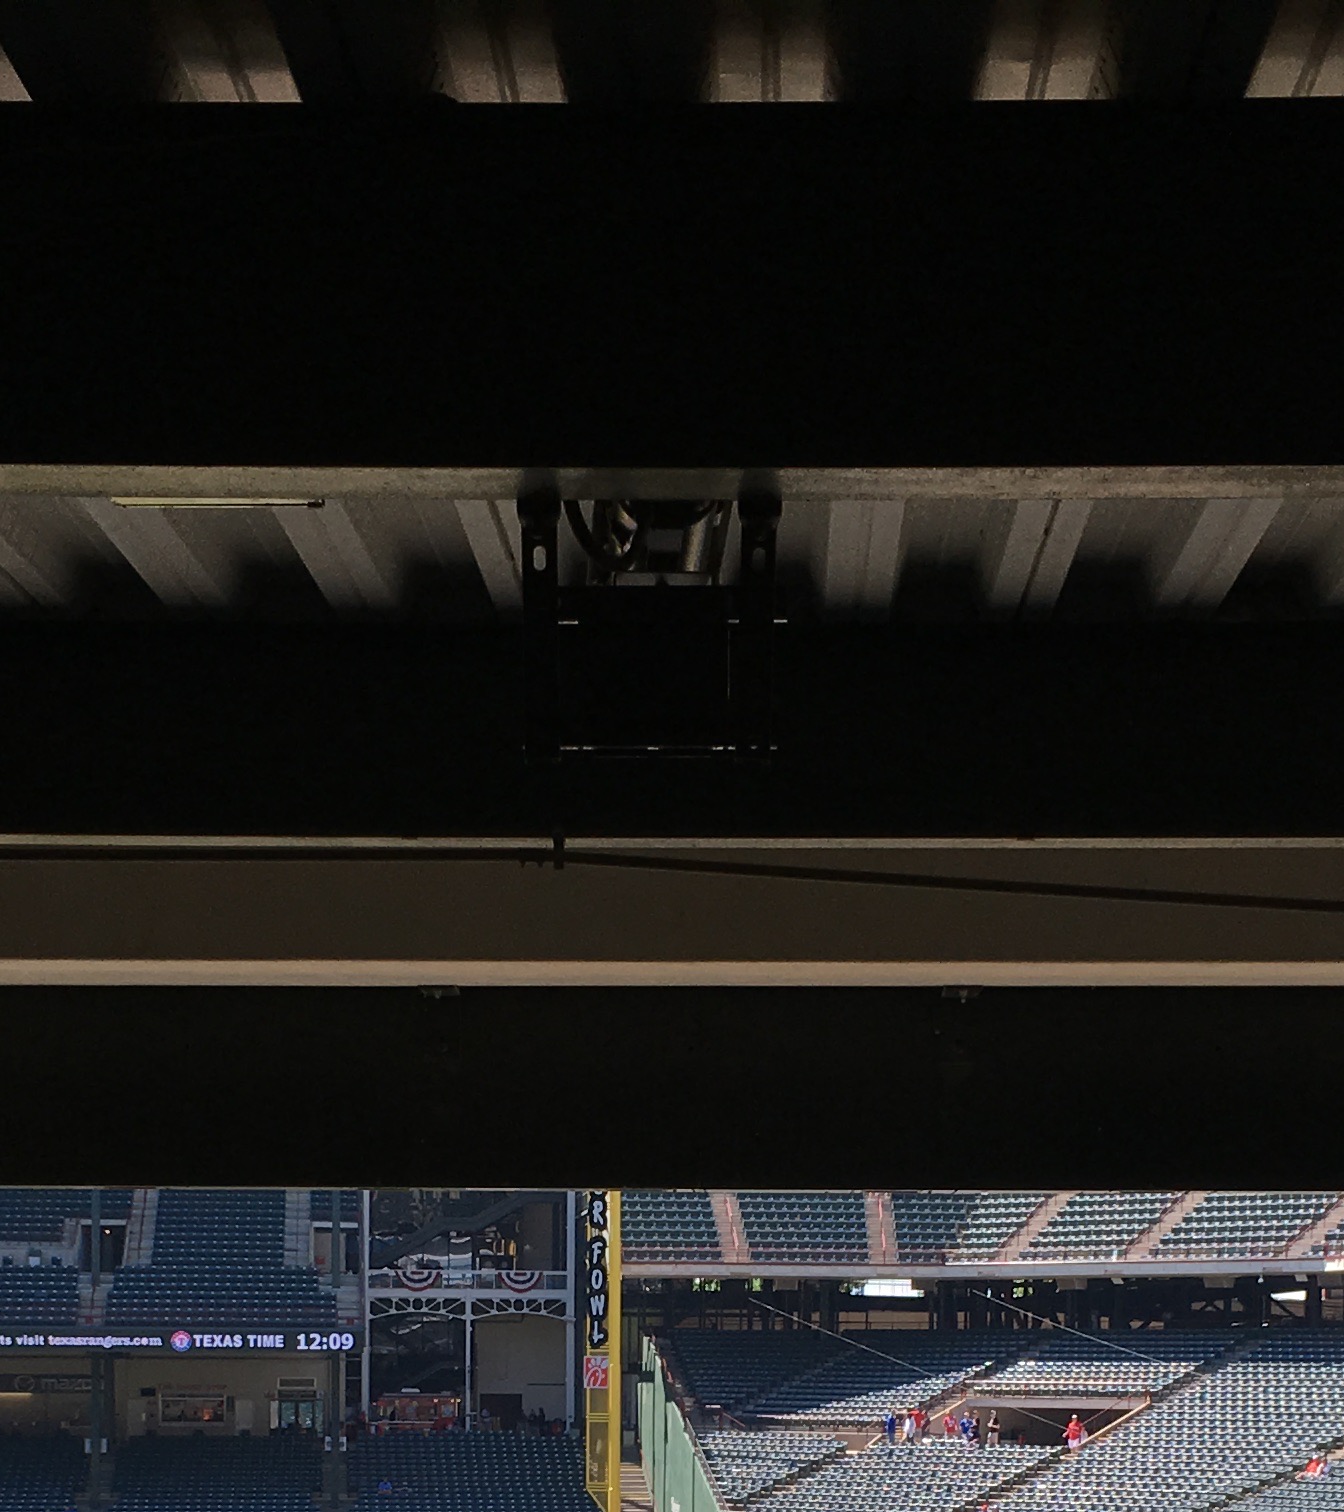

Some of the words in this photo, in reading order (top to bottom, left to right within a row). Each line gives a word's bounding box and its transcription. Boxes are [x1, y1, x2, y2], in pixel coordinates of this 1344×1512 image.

[590, 1241, 606, 1344] FOWL
[16, 1334, 45, 1346] visit
[48, 1334, 163, 1348] texasrangers.com
[193, 1334, 243, 1348] TEXAS
[246, 1335, 285, 1348] TIME
[296, 1333, 354, 1350] 12:09
